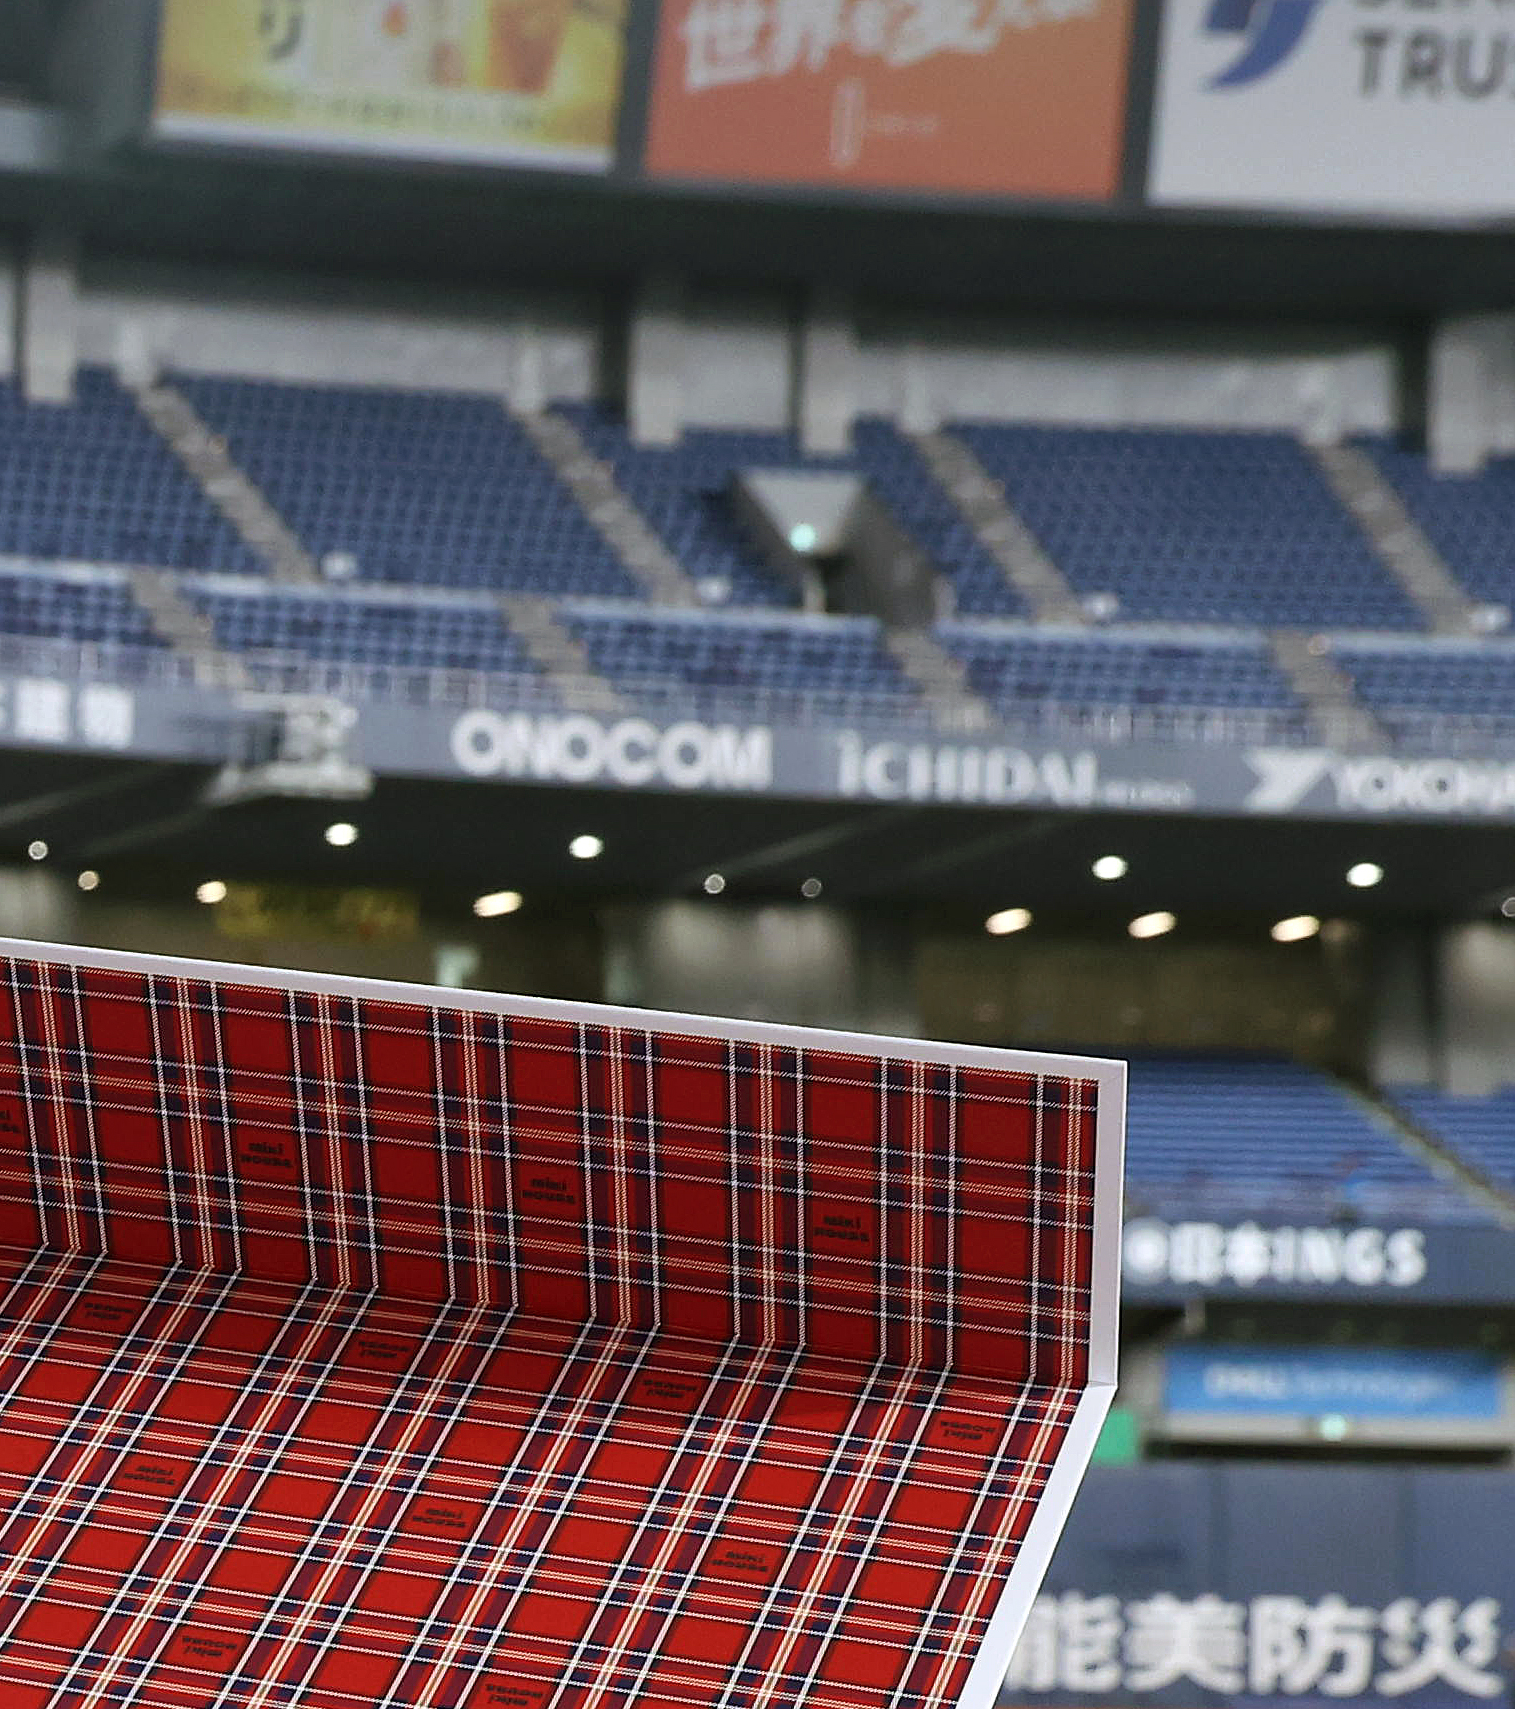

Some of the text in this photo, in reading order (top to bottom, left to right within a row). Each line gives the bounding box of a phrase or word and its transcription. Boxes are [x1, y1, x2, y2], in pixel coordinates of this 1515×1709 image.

[1356, 25, 1515, 103] TRU
[450, 708, 772, 792] ONOCOM
[1004, 1592, 1505, 1700] 能美防災
